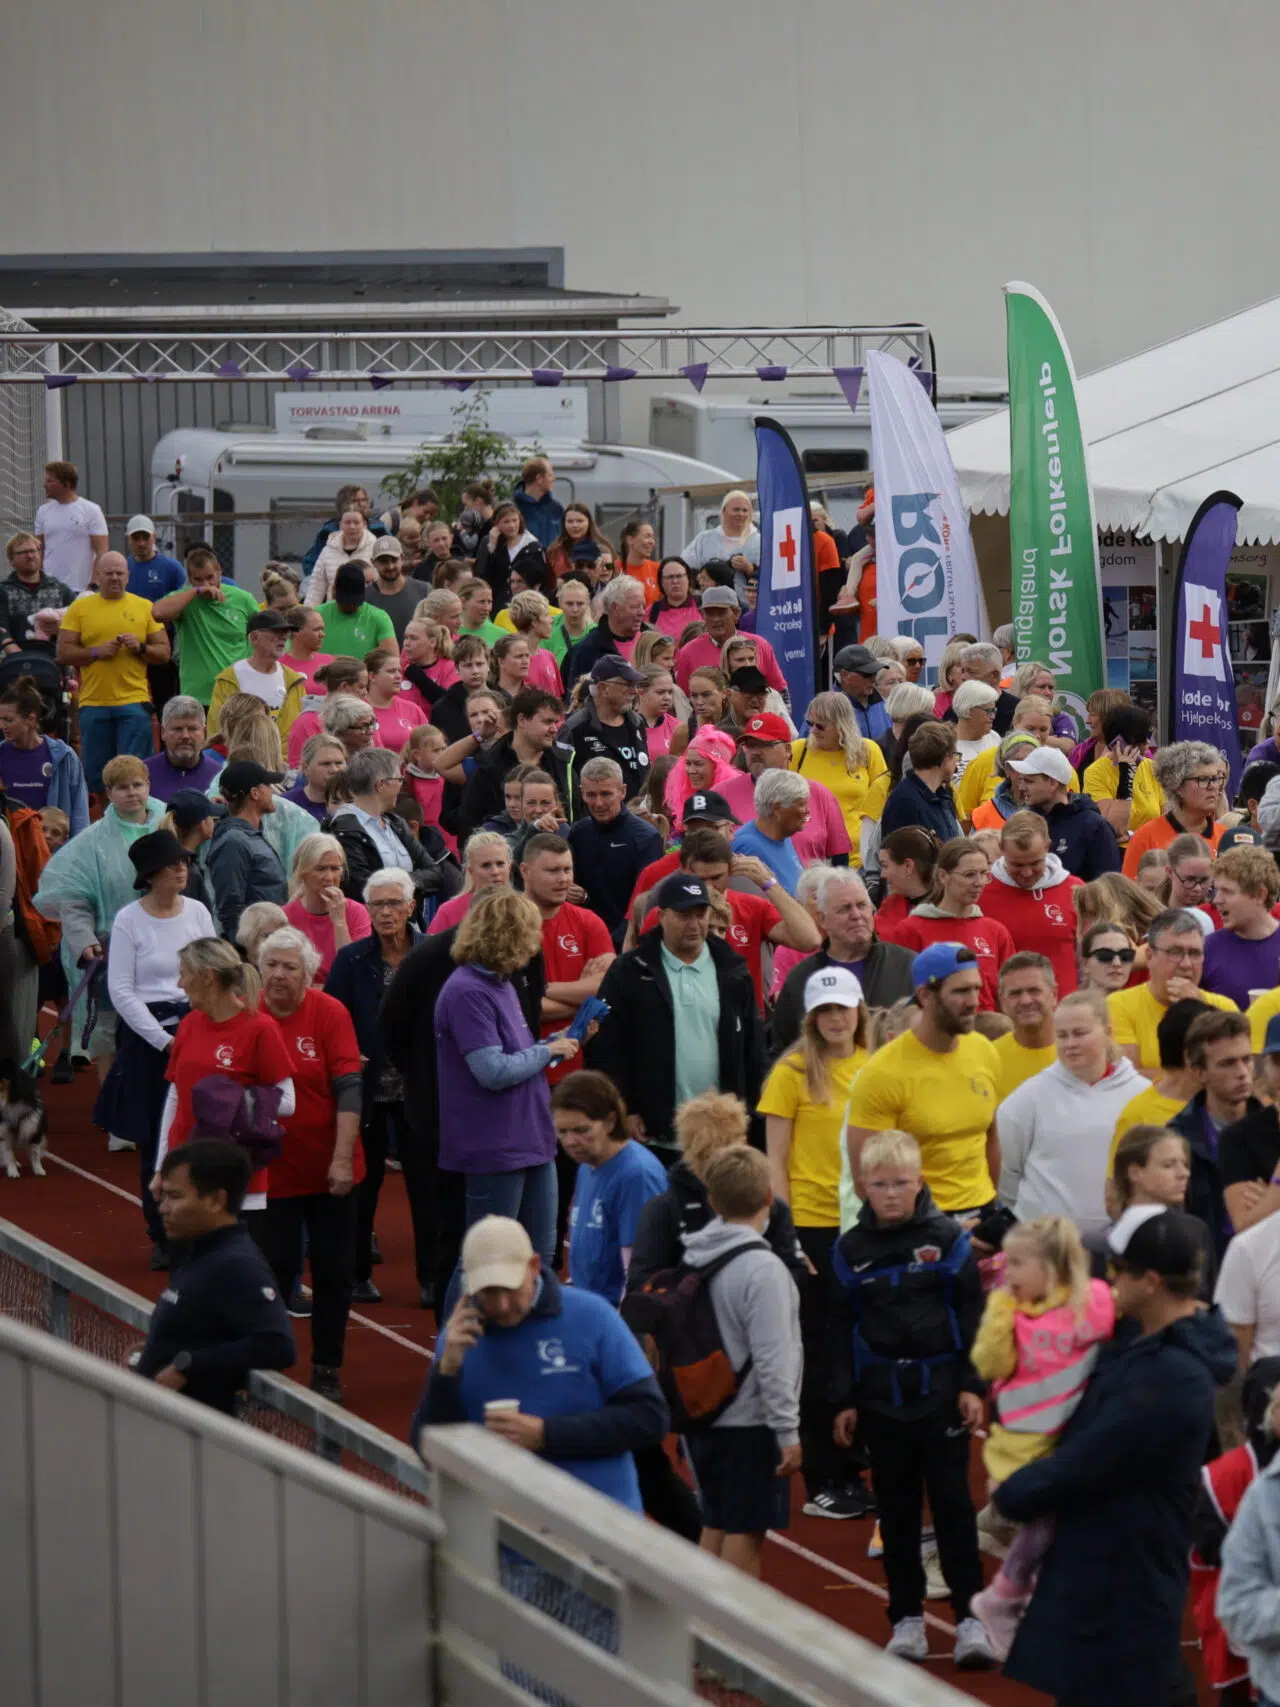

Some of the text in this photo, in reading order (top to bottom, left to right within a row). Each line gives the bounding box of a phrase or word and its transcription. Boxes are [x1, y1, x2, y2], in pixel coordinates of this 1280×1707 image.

[290, 405, 401, 417] TORVASTAD ARENA
[1099, 531, 1125, 547] de
[1099, 552, 1136, 568] gdom
[1229, 553, 1267, 567] msorg
